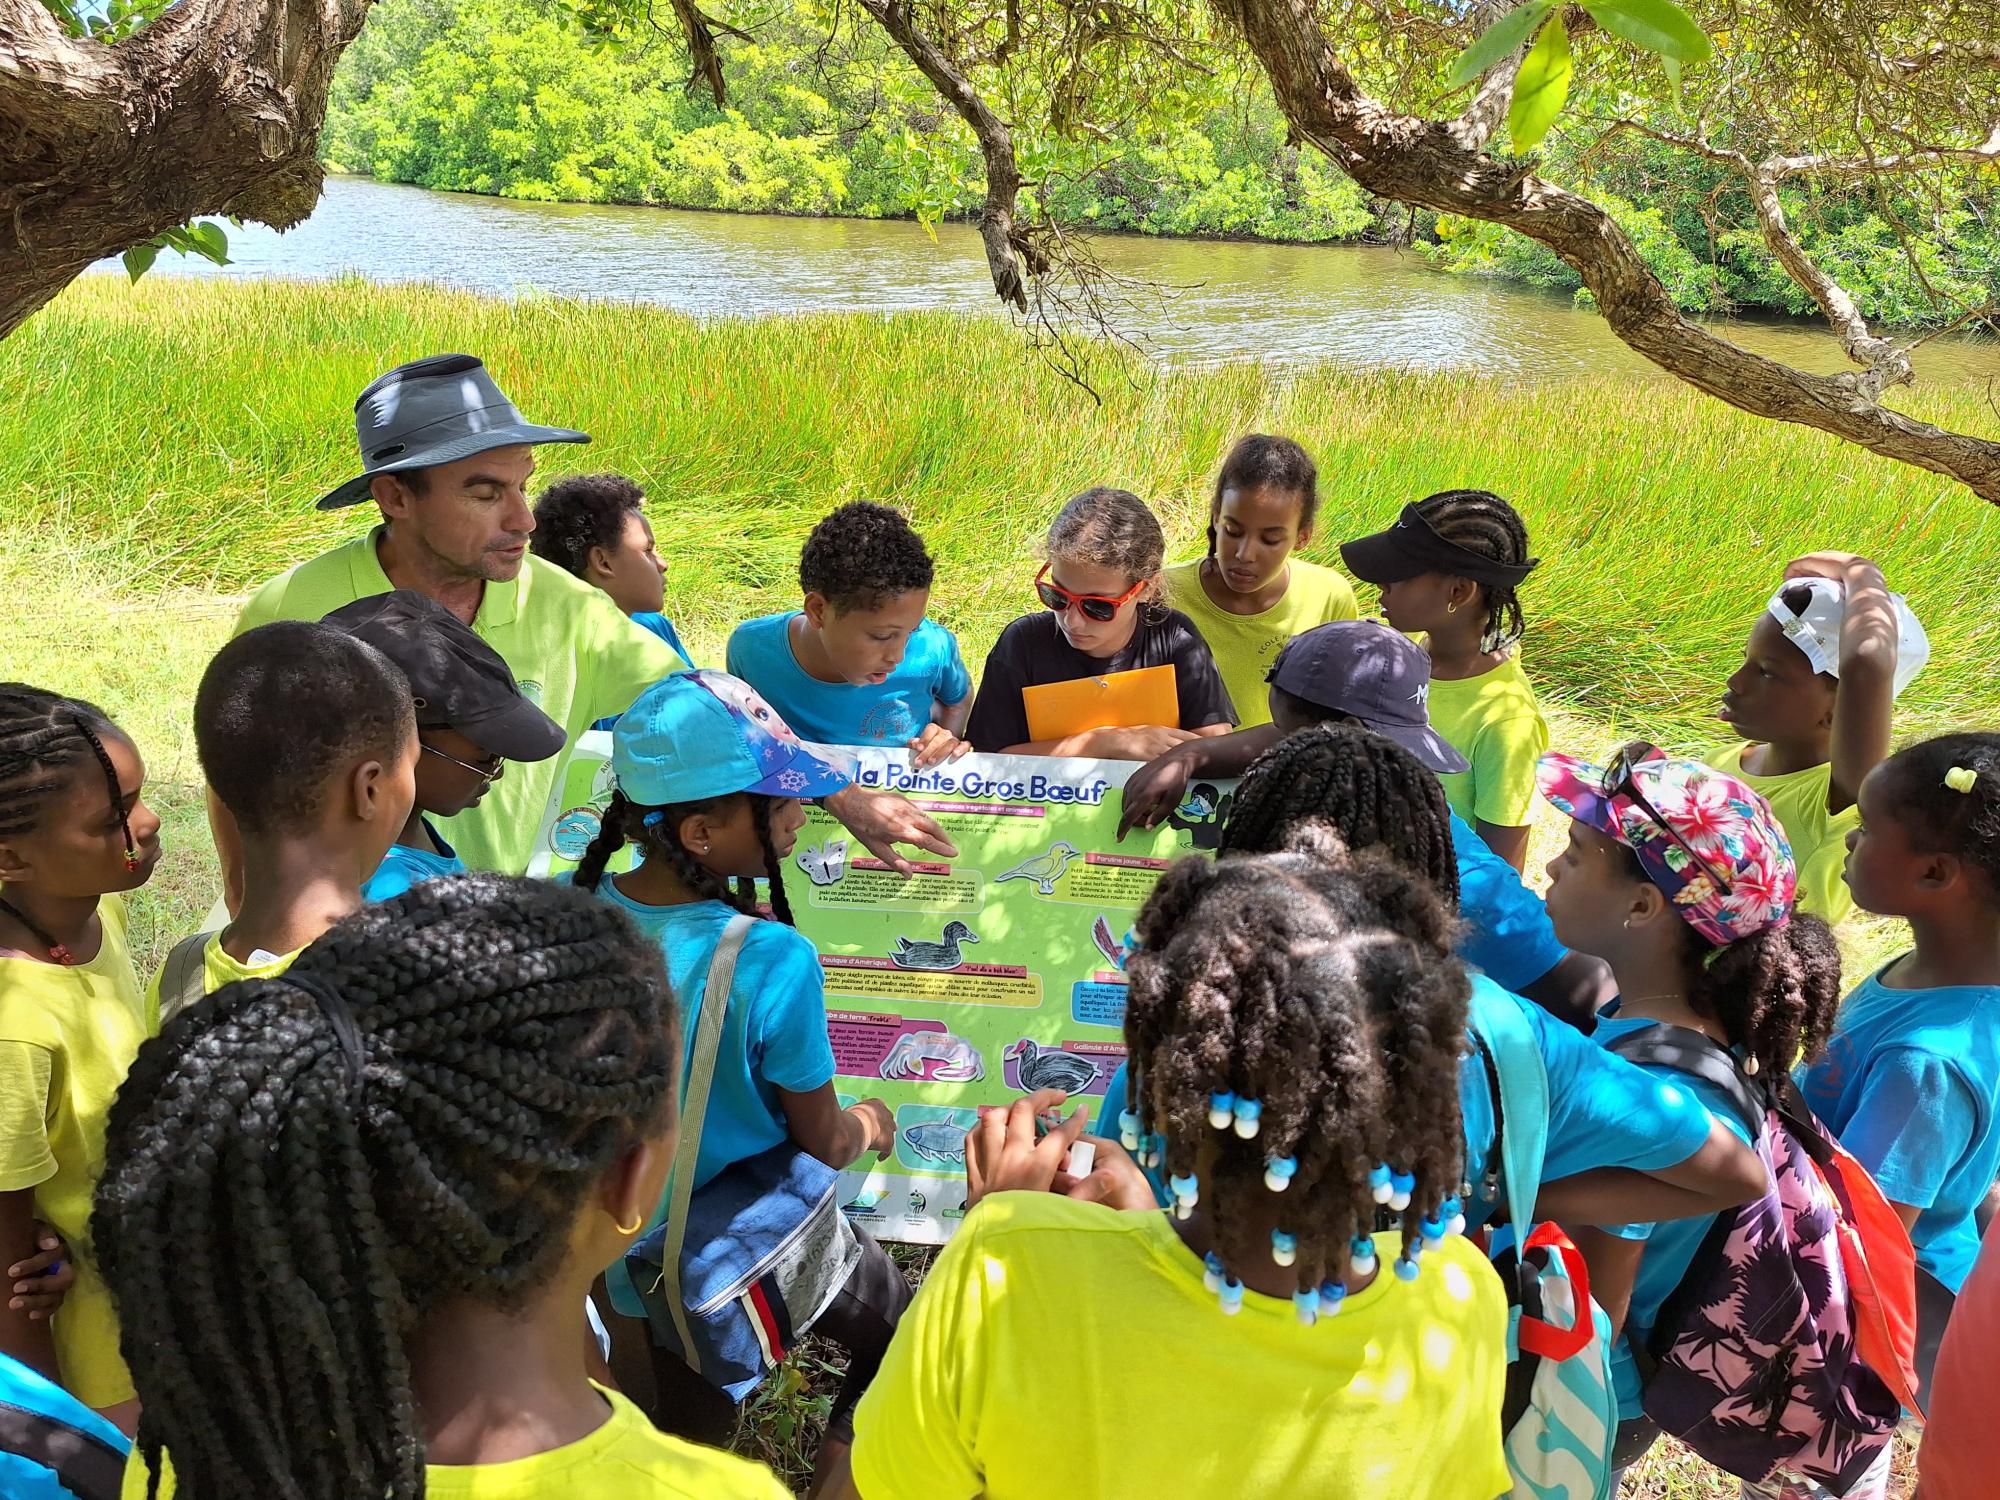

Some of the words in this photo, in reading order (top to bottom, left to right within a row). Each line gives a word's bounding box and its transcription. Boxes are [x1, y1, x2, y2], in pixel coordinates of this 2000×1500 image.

[854, 760, 878, 784] la
[886, 764, 956, 791] Pointe
[961, 772, 1025, 798] Gros
[1030, 776, 1109, 802] Bœuf
[822, 956, 848, 965] Foulque
[826, 1011, 839, 1019] abe
